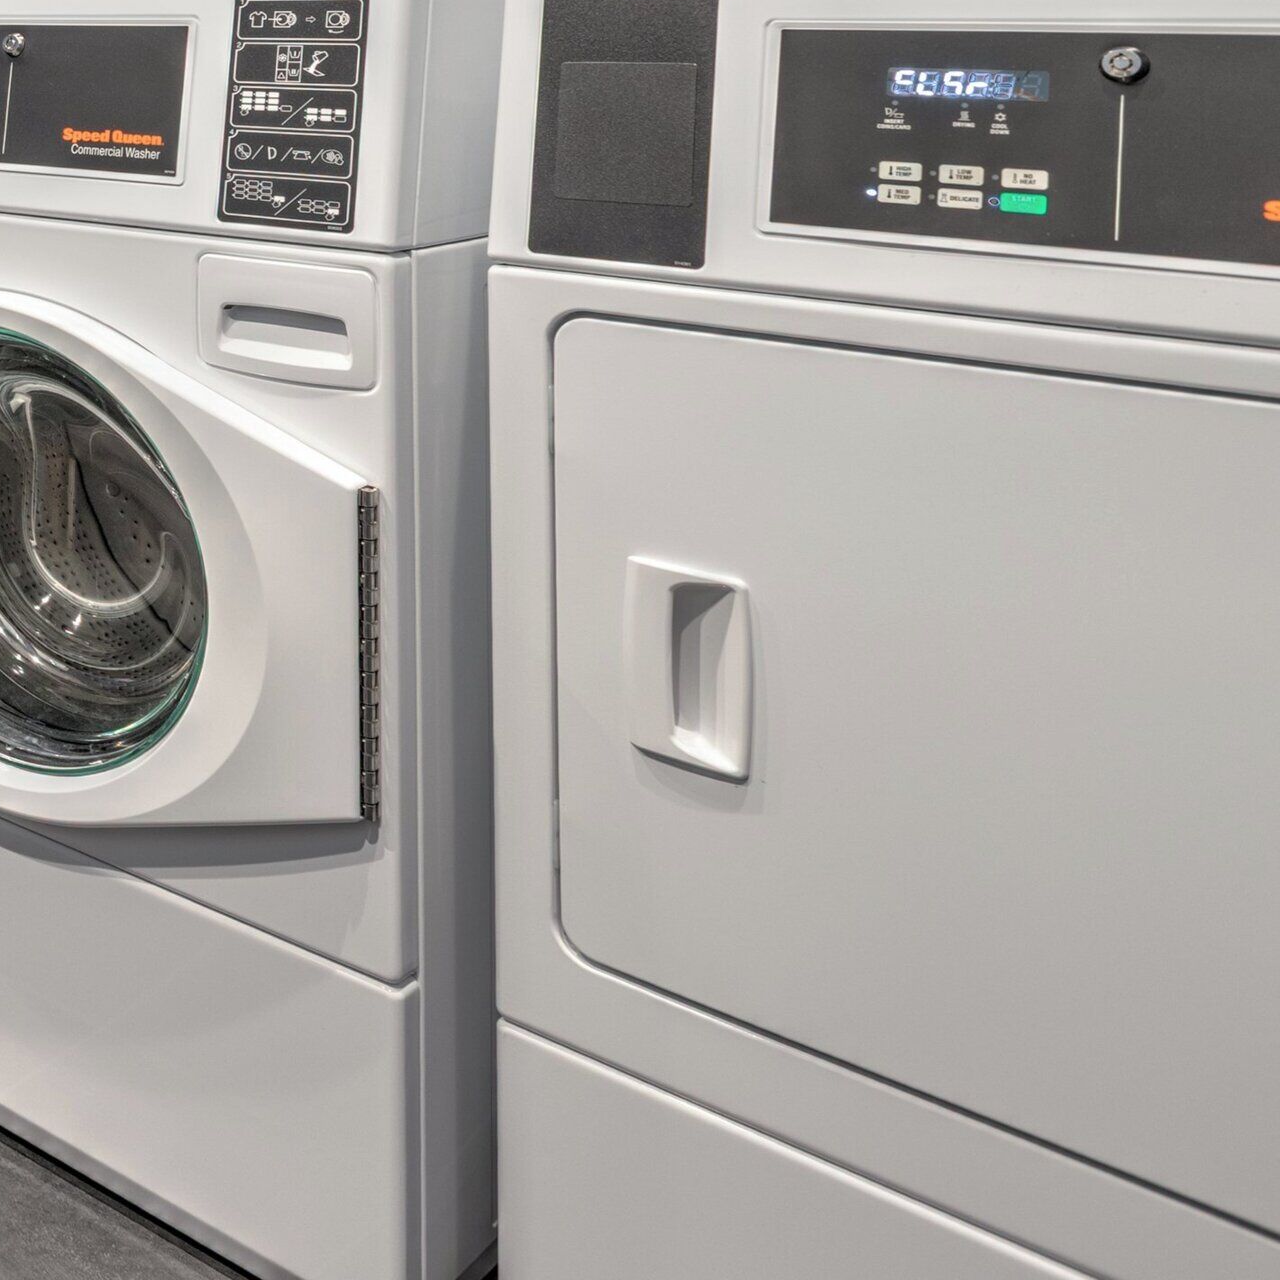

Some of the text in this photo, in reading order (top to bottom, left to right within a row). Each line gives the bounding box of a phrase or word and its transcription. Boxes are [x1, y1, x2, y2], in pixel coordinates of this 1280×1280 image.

[62, 127, 163, 146] Speed Queen
[70, 143, 161, 160] Commercial Washer
[949, 195, 980, 203] DELICATE
